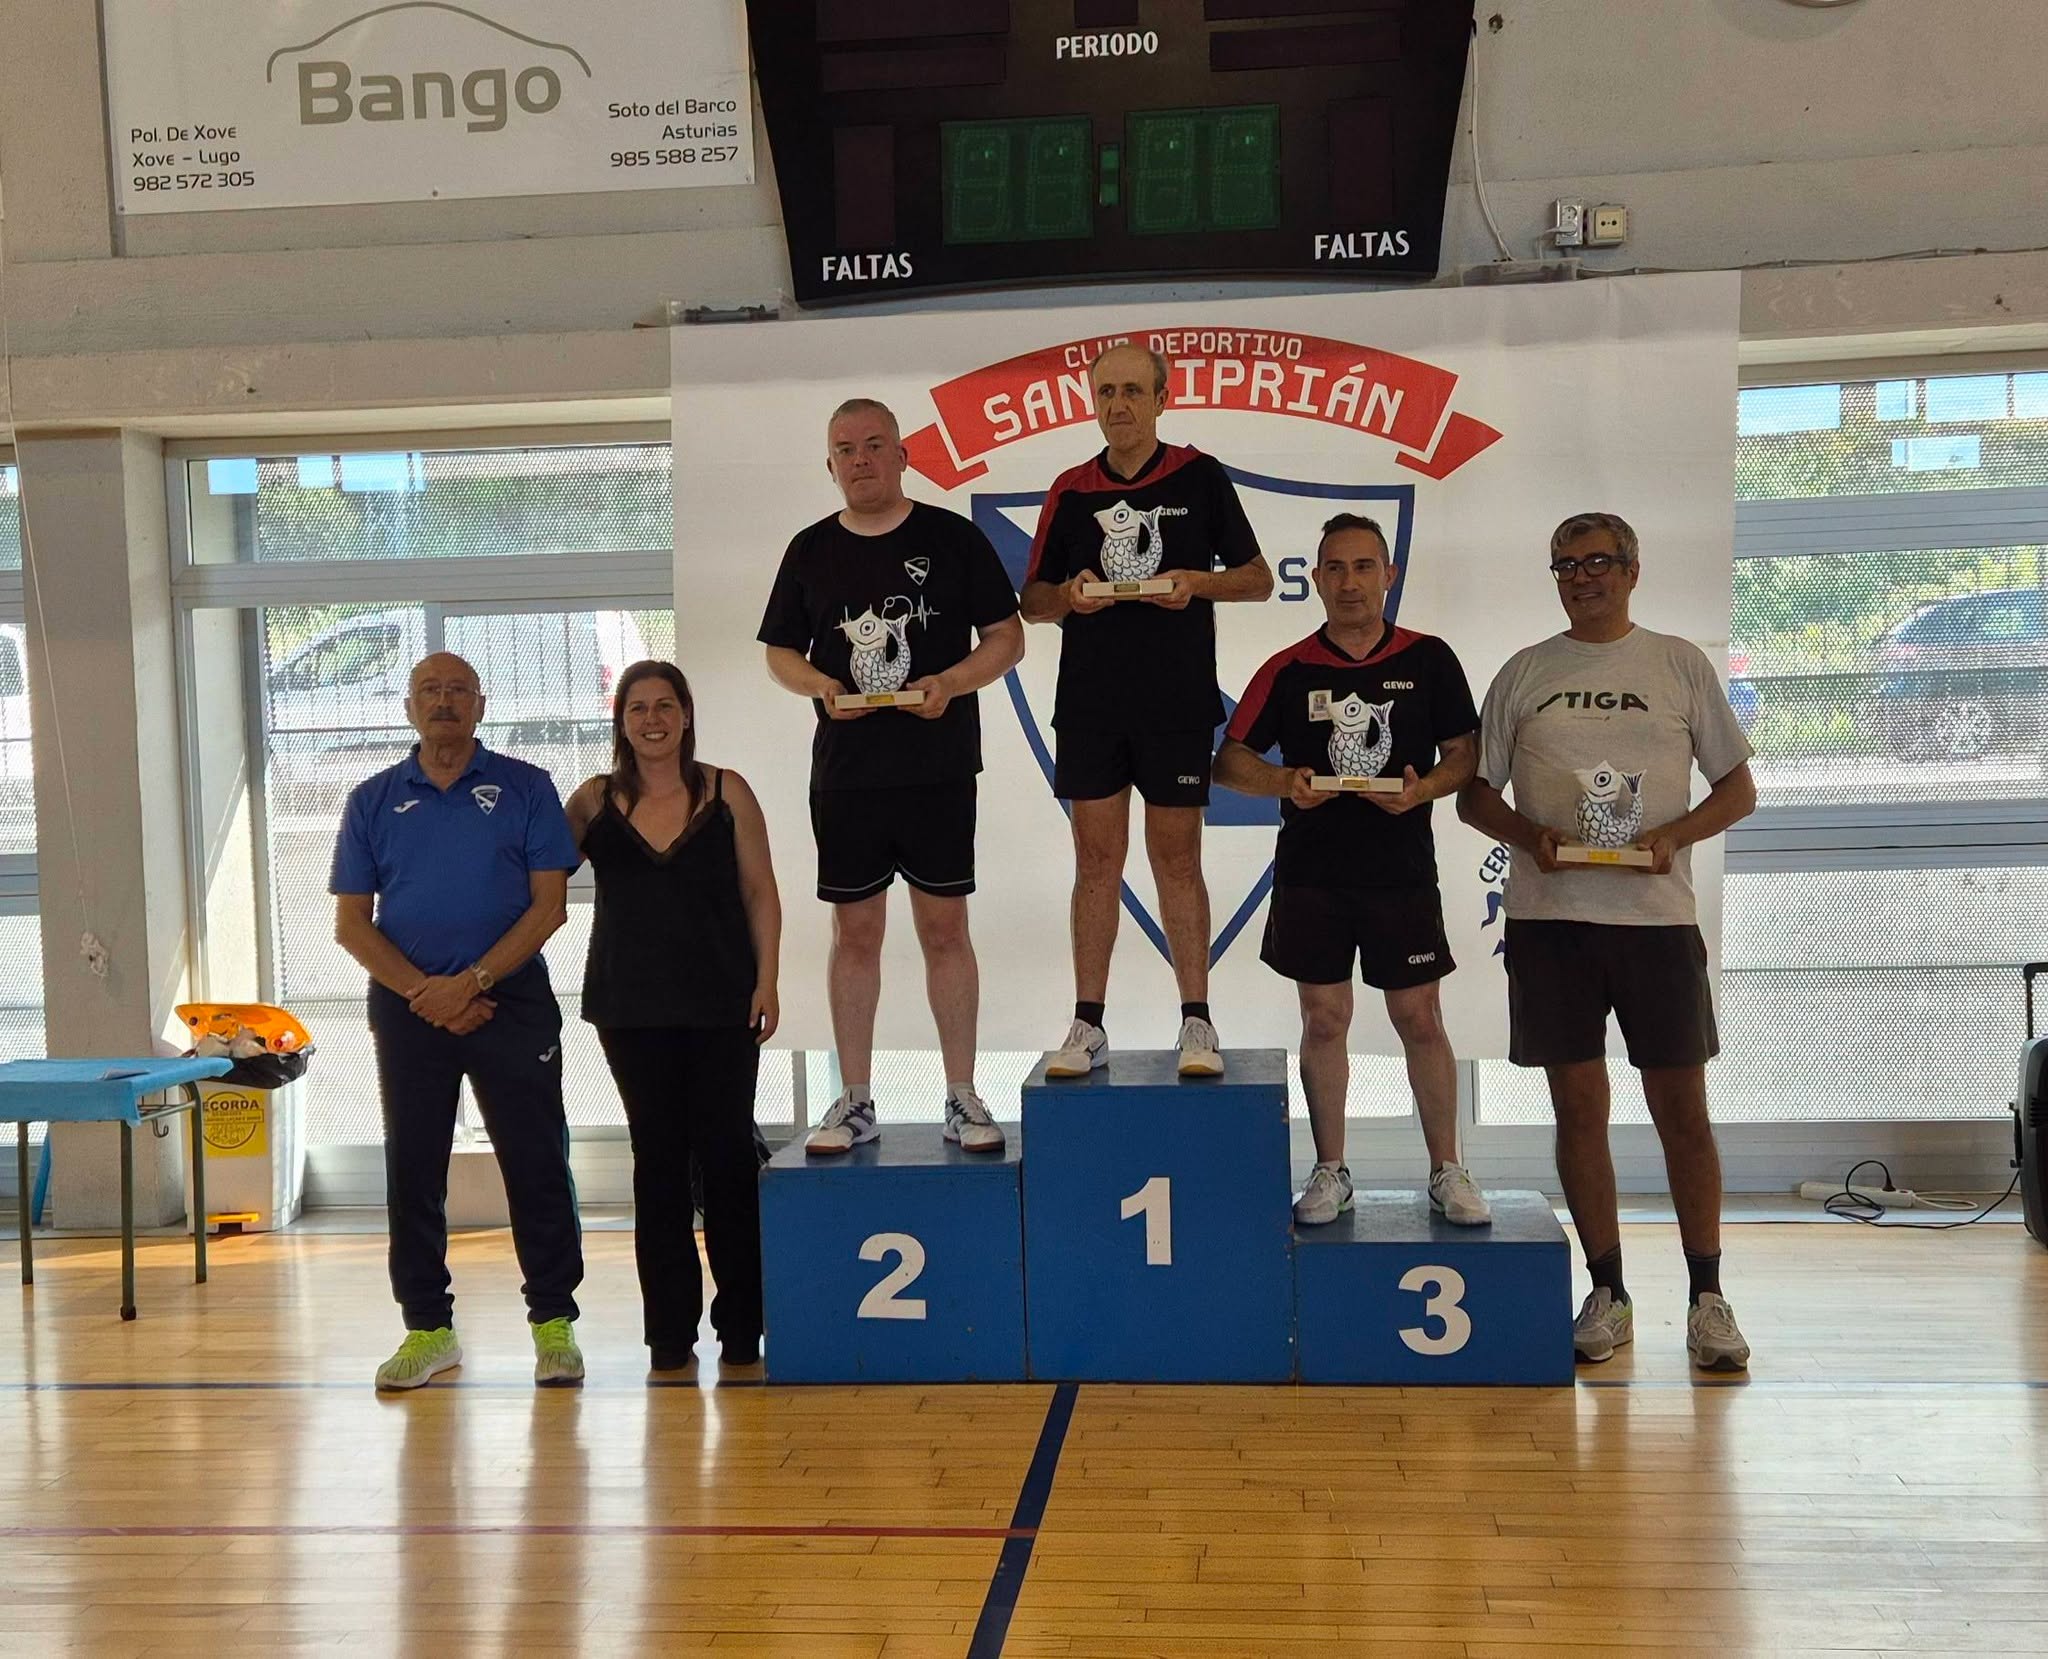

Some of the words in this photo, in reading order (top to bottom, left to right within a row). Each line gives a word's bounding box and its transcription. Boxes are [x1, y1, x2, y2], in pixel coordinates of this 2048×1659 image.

[1055, 31, 1158, 59] PERIODO
[298, 61, 561, 133] Bango
[608, 102, 650, 119] Soto
[655, 100, 679, 116] del
[685, 99, 737, 115] Barco
[131, 128, 162, 144] Pol.
[167, 126, 189, 142] De
[194, 124, 237, 141] Xove
[662, 122, 738, 140] Asturias
[132, 152, 175, 168] Xove
[199, 149, 240, 166] Lugo
[610, 150, 650, 168] 985
[655, 148, 696, 165] 588
[701, 146, 739, 163] 257
[133, 175, 172, 192] 982
[176, 173, 213, 190] 572
[217, 171, 255, 187] 305
[1314, 230, 1410, 261] FALTAS
[822, 252, 913, 282] FALTAS
[1064, 337, 1129, 369] CL
[1149, 332, 1303, 361] DEPORTIVO
[982, 369, 1096, 442] SAN
[1174, 358, 1405, 435] IPRIÁN
[1160, 507, 1189, 516] GEWO
[1382, 681, 1415, 690] GEWO
[1537, 691, 1649, 712] STIGA
[1177, 775, 1200, 785] GEWO
[1408, 951, 1436, 964] GEWO
[202, 1099, 260, 1112] ECORDA
[1121, 1177, 1172, 1265] 1
[857, 1232, 927, 1320] 2
[1398, 1265, 1472, 1355] 3
